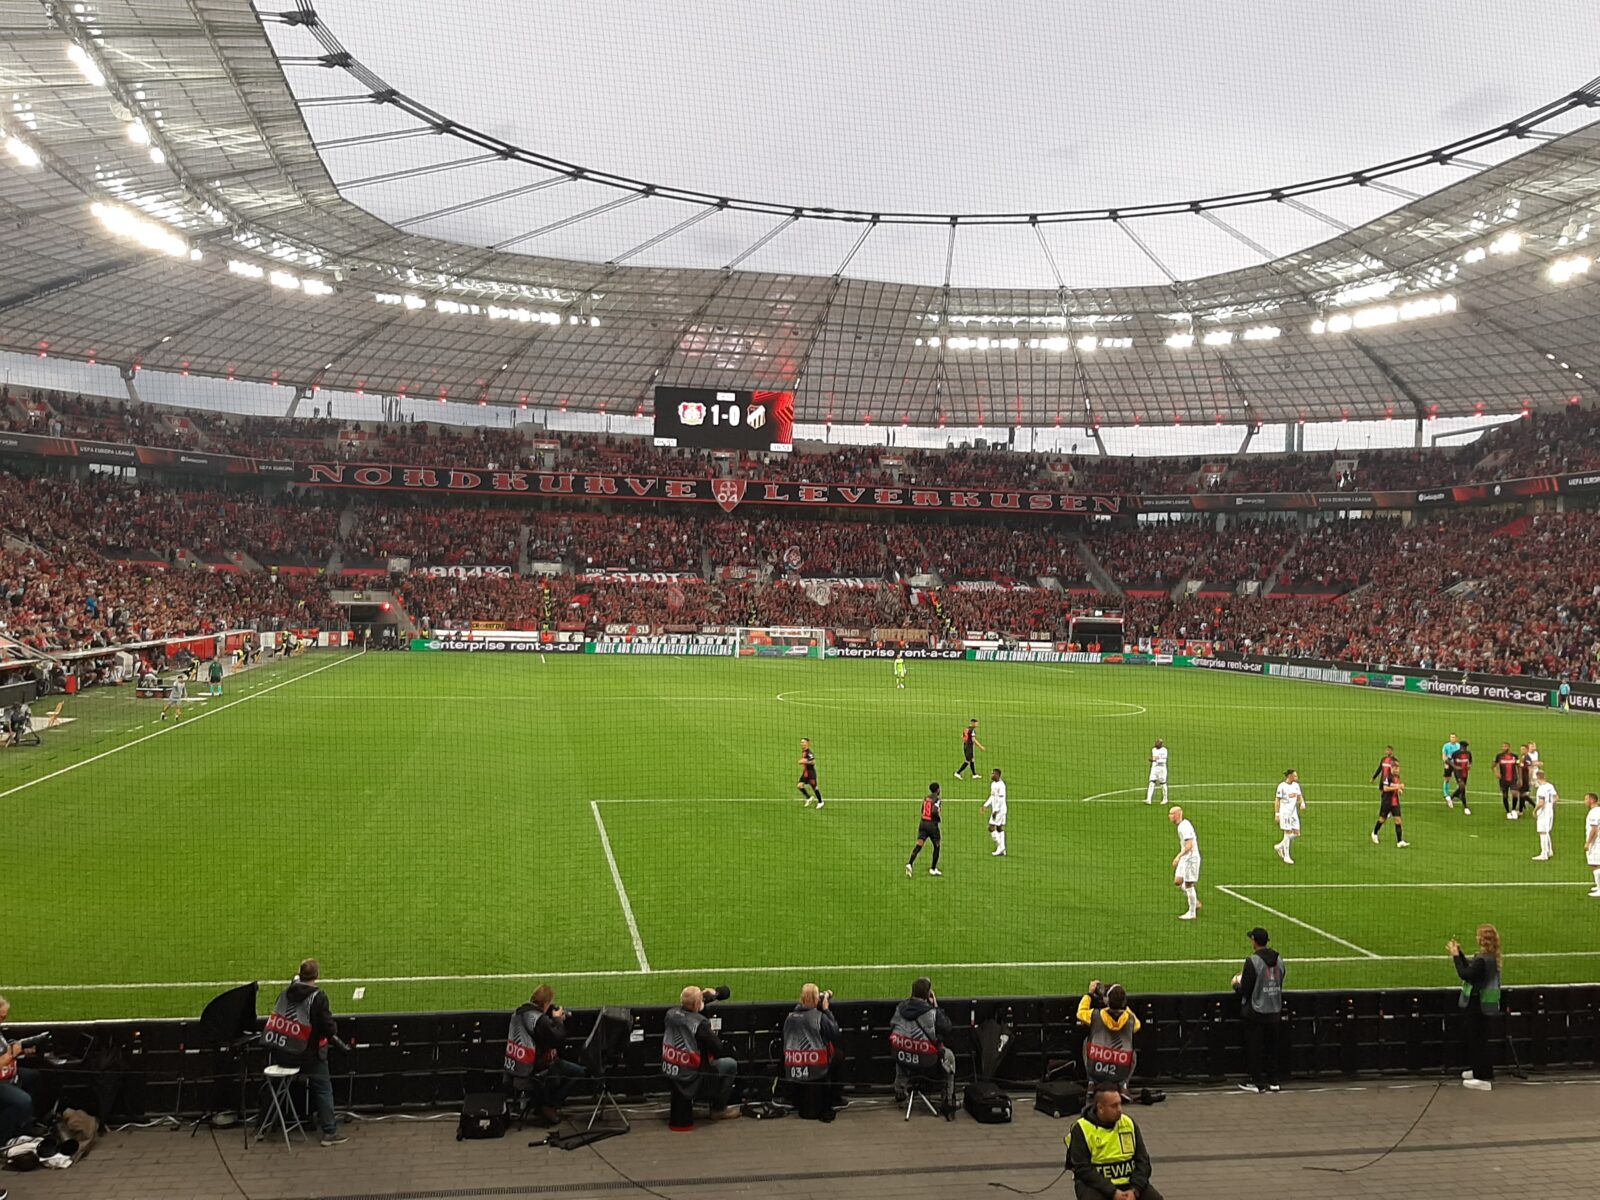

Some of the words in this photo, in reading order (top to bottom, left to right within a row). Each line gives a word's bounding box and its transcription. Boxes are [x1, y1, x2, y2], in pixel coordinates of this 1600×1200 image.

[308, 464, 697, 498] NORDKURVE
[764, 484, 1121, 513] LEVERKUSEN
[429, 640, 506, 652] enterprise
[510, 641, 581, 651] rent-a-car
[827, 647, 895, 658] enterprise
[900, 648, 963, 659] rent-a-car
[1190, 656, 1226, 669] enterprise
[1227, 658, 1263, 672] rent-a-car
[1418, 679, 1480, 695] enterprise
[1483, 686, 1547, 702] rent-a-car
[1569, 695, 1595, 708] UEFA
[890, 1034, 929, 1052] PHOTO
[785, 1051, 819, 1063] PHOTO
[1089, 1046, 1128, 1063] PHOTO
[791, 1066, 809, 1078] 034
[1095, 1061, 1117, 1075] 042
